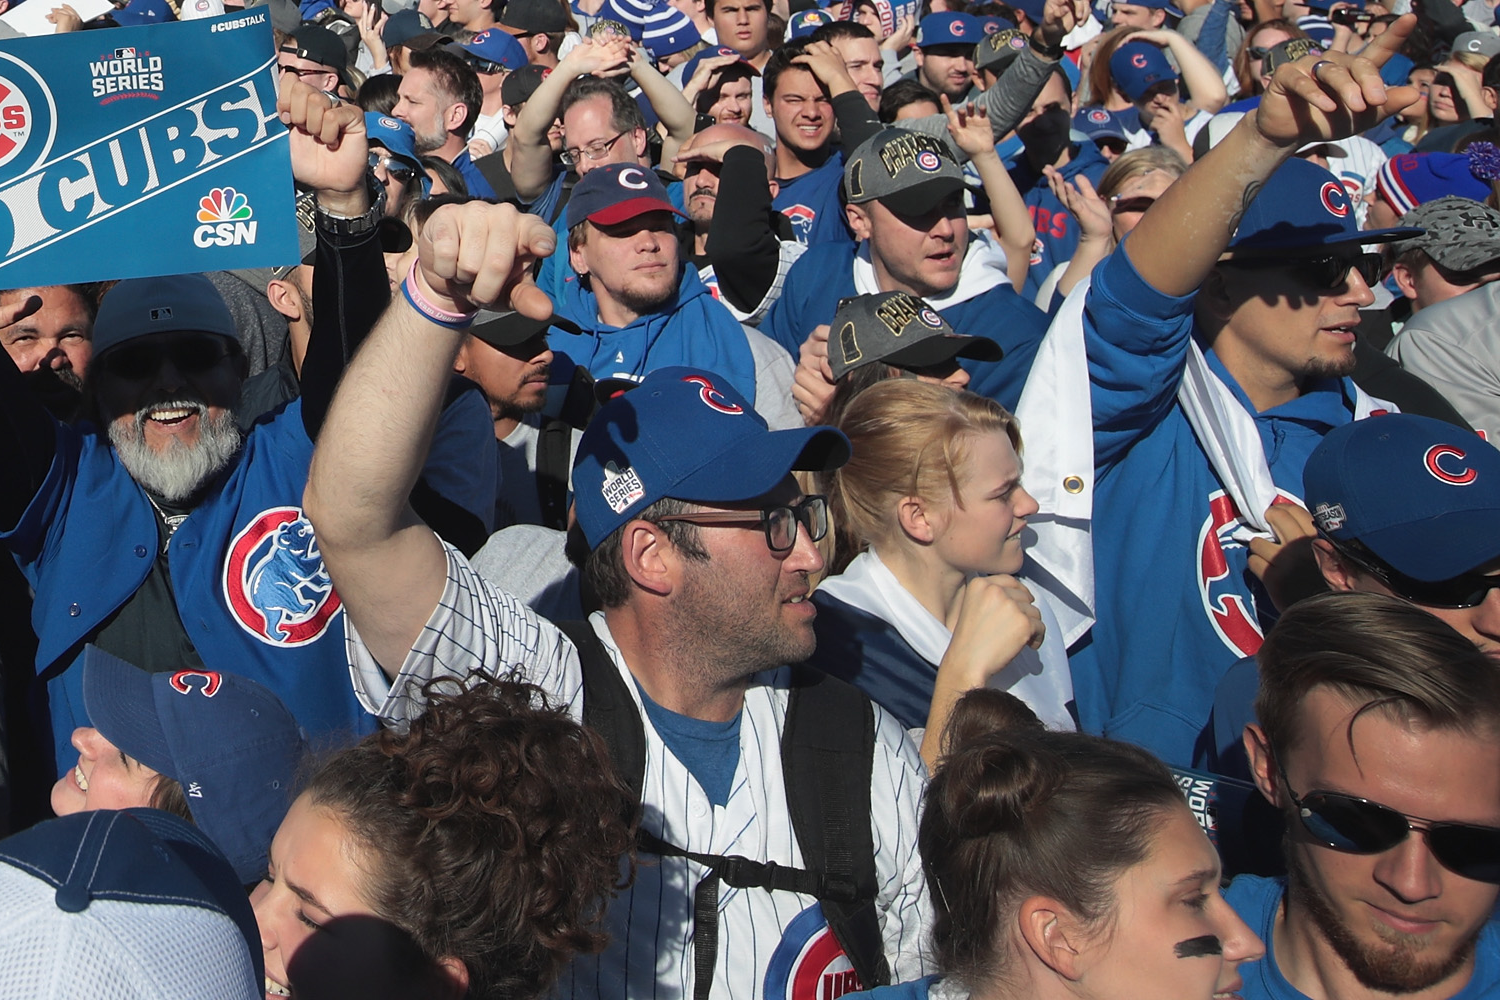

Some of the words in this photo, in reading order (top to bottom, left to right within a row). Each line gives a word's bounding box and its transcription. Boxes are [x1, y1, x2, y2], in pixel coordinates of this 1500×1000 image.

[210, 14, 266, 34] #CUBSTALK
[949, 20, 966, 37] C
[90, 56, 162, 77] WORLD
[92, 72, 164, 98] SERIES
[618, 167, 648, 190] C
[1320, 182, 1349, 218] C
[193, 220, 257, 248] CSN
[1423, 443, 1478, 486] C
[603, 470, 634, 497] WORLD
[609, 478, 641, 508] SERIES
